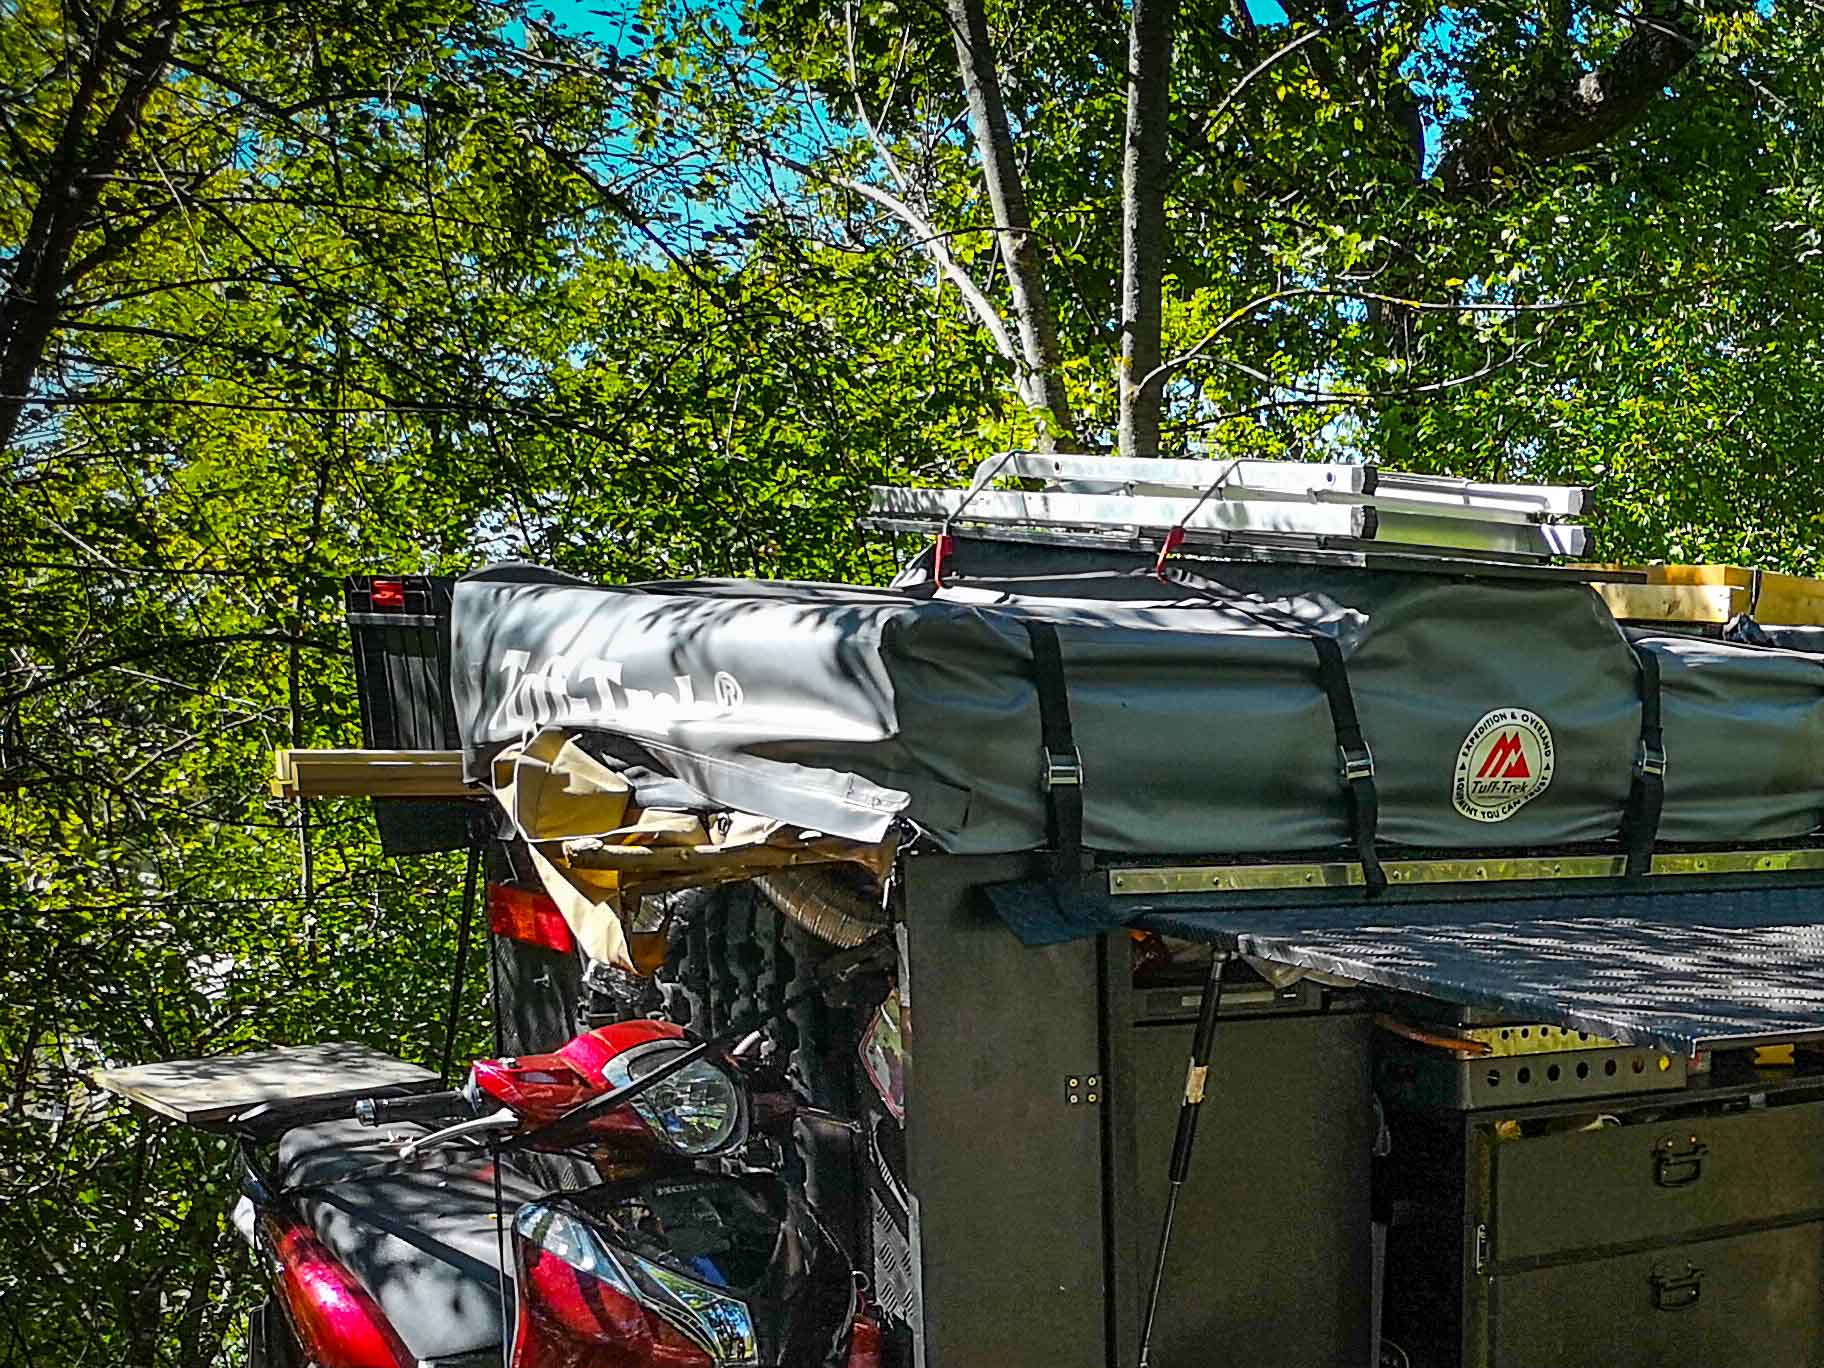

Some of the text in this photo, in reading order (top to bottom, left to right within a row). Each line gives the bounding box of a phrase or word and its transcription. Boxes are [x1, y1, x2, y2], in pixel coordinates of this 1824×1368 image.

[1461, 711, 1552, 757] EXPEDITION & OVERLAND
[1471, 780, 1530, 795] Tuff-Trek
[1480, 810, 1500, 819] YOU
[1501, 798, 1522, 815] CAN
